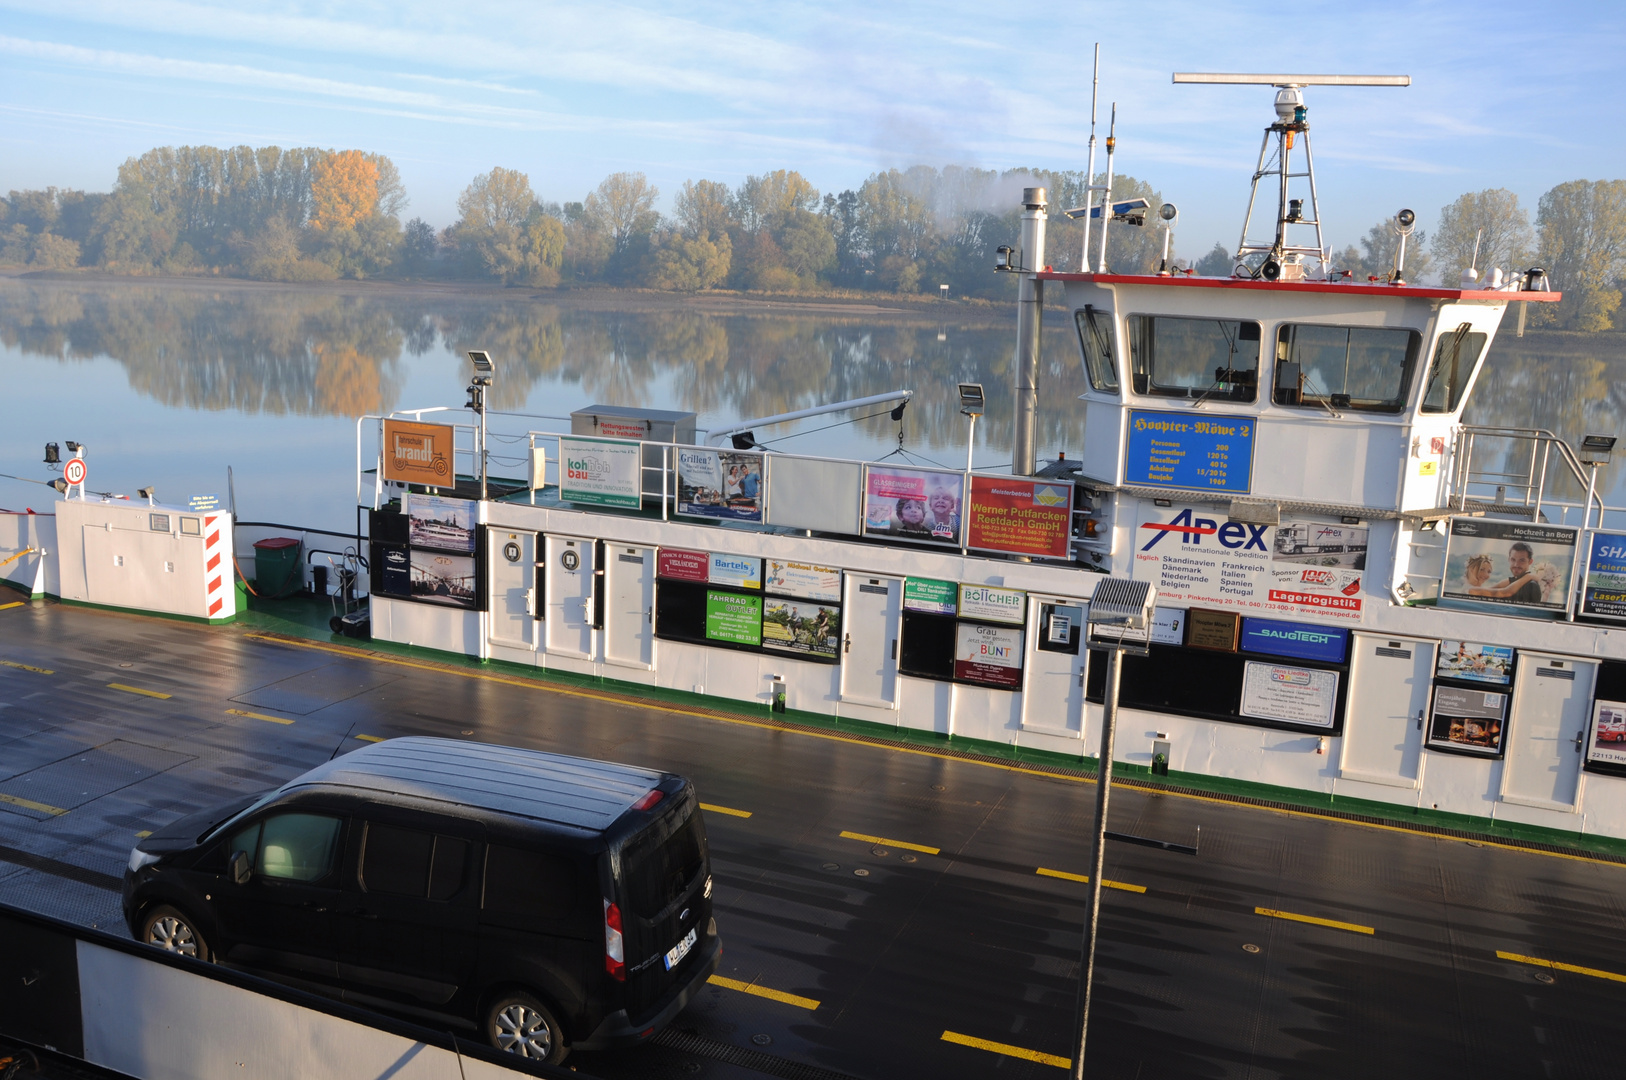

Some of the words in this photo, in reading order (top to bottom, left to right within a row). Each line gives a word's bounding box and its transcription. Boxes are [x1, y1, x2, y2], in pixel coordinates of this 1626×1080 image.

[600, 422, 644, 432] Rettungswesten
[1240, 426, 1249, 437] 2
[396, 435, 433, 462] brandt
[1152, 440, 1180, 448] Personen
[1151, 448, 1185, 456] Gesamtlast
[568, 458, 588, 470] koh
[680, 454, 712, 465] Grillen?
[70, 466, 81, 478] 10
[568, 468, 588, 480] bau
[1148, 473, 1172, 481] Baujahr
[1197, 468, 1218, 476] 15/20
[568, 481, 592, 489] TRADITION
[604, 485, 634, 493] INNOVATION
[991, 488, 1032, 498] Meisterbetrieb
[972, 503, 1008, 516] Werner
[1010, 506, 1067, 522] Putfarcken
[936, 523, 951, 532] dm
[977, 514, 1024, 528] Reetdach
[1027, 520, 1060, 532] GmbH
[1514, 528, 1544, 538] Hochzeit
[1556, 532, 1573, 541] Bord
[982, 537, 1052, 549] www.putfarcken-reetdach.de
[1182, 546, 1230, 556] Internationale
[1234, 551, 1268, 561] Spedition
[715, 559, 748, 570] Bartels
[788, 562, 812, 570] Michael
[1163, 556, 1216, 568] Skandinavien
[1222, 562, 1265, 572] Frankreich
[1162, 564, 1202, 574] Dänemark
[1222, 570, 1246, 579] Italien
[1161, 572, 1209, 583] Niederlande
[1220, 578, 1252, 588] Spanien
[1160, 580, 1190, 590] Belgien
[1220, 586, 1254, 596] Portugal
[709, 594, 746, 605] FAHRRAD
[965, 588, 1020, 606] BÖTTCHER
[1273, 592, 1356, 608] Lagerlogistik
[726, 604, 758, 615] OUTLET
[1158, 591, 1182, 600] amburg
[1187, 594, 1223, 605] Pinkertweg
[1300, 608, 1361, 620] www.apexsped.de
[976, 626, 996, 636] Grau
[1261, 629, 1328, 644] SAUGTECH
[980, 644, 1012, 658] BUNT
[1438, 694, 1466, 702] Ganzjährig
